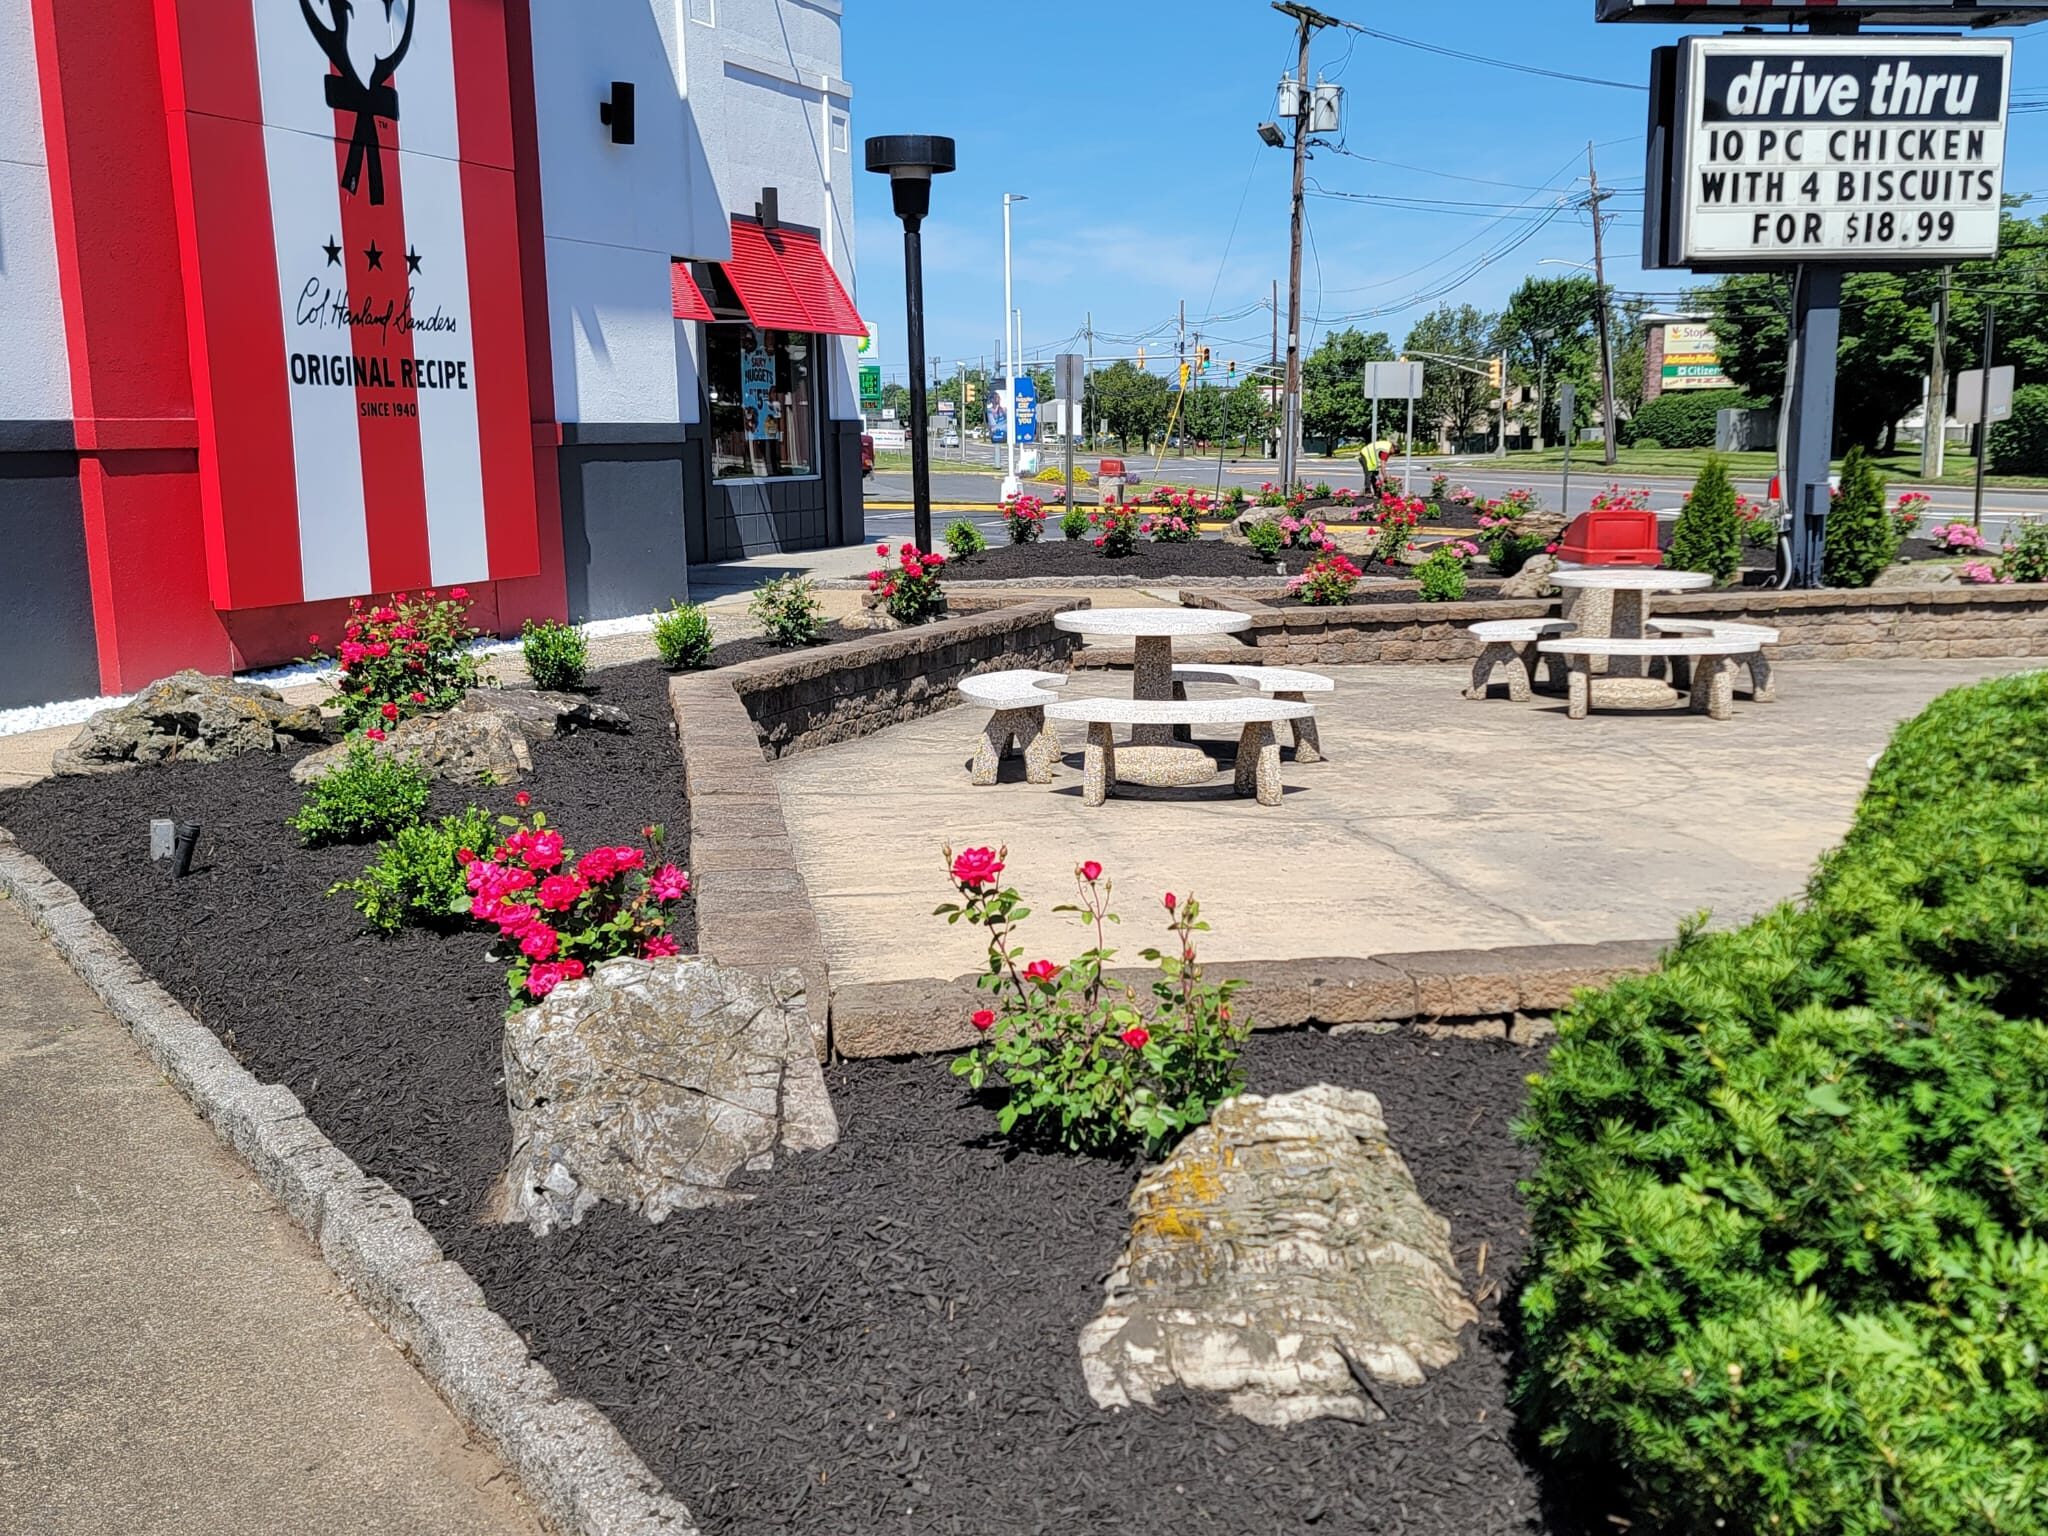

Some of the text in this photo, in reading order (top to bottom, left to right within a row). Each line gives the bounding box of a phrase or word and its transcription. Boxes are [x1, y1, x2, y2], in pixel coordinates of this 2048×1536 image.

[1726, 60, 1979, 116] drive thru
[1708, 129, 1984, 162] 10 PC CHICKEN
[1701, 170, 1994, 203] WITH 4 BISCUITS
[1752, 211, 1955, 245] FOR $18.99
[296, 276, 457, 346] Col. Harland Sanders
[290, 352, 468, 390] ORIGINAL RECIPE
[744, 367, 774, 385] NUGGETS
[1687, 366, 1723, 376] Citizen
[360, 402, 417, 418] SINCE 1940
